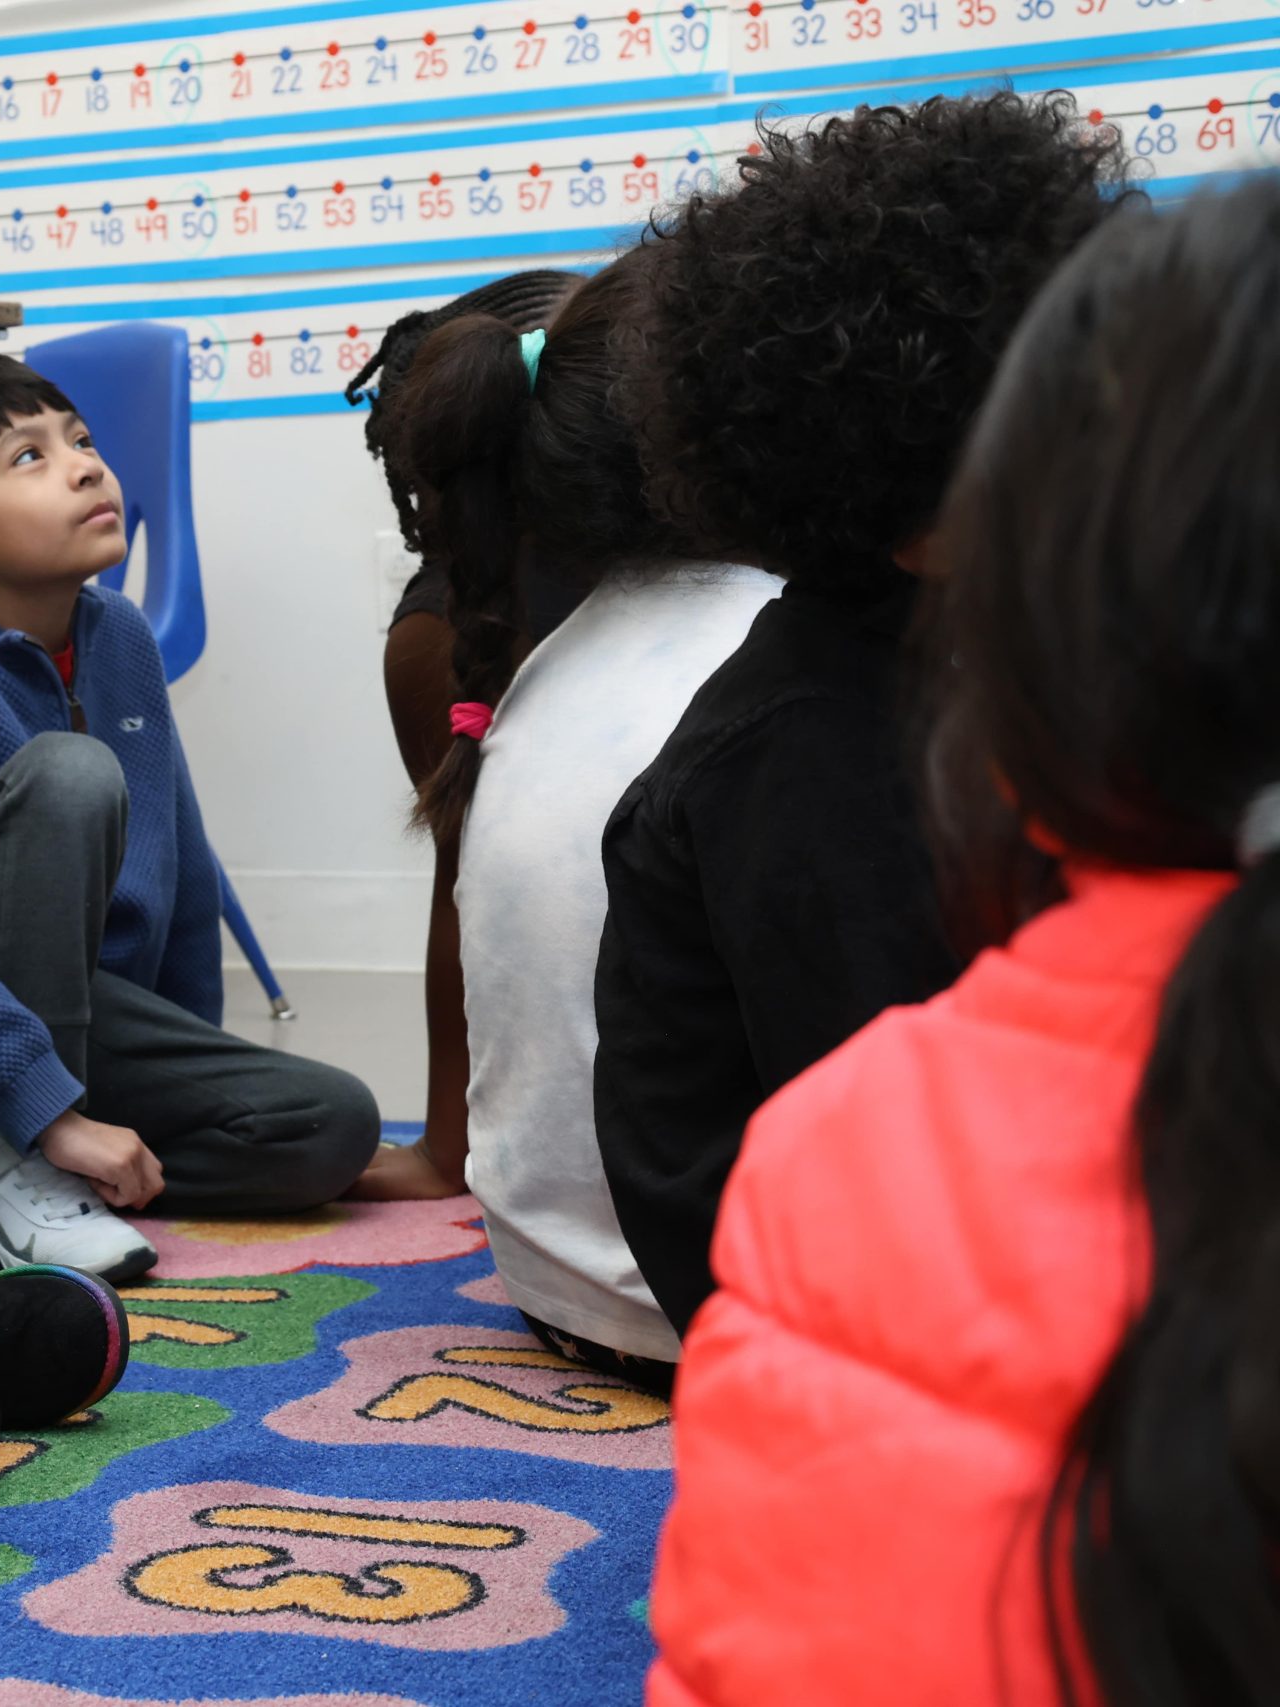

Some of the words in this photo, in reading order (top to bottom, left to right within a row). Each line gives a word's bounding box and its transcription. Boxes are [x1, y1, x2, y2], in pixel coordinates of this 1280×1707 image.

[42, 86, 62, 116] 17
[86, 82, 109, 112] 18
[130, 77, 151, 108] 19
[170, 77, 200, 106] 20
[230, 68, 251, 99] 21
[272, 64, 302, 95] 22
[320, 59, 350, 90] 23
[366, 55, 398, 86] 24
[415, 48, 448, 80] 25
[464, 44, 497, 76] 26
[514, 38, 546, 70] 27
[565, 32, 600, 65] 28
[618, 27, 652, 60] 29
[670, 24, 709, 54] 30
[744, 18, 769, 52] 31
[792, 14, 827, 47] 32
[845, 7, 882, 41] 33
[900, 1, 938, 35] 34
[957, 0, 997, 29] 35
[1132, 123, 1178, 158] 68
[1196, 117, 1235, 151] 69
[2, 226, 34, 252] 46
[47, 219, 78, 248] 47
[91, 218, 124, 245] 48
[135, 214, 168, 241] 49
[182, 212, 216, 240] 50
[233, 203, 256, 235] 51
[277, 202, 306, 231] 52
[323, 198, 355, 227] 53
[370, 195, 404, 224] 54
[418, 189, 454, 220] 55
[468, 186, 503, 216] 56
[518, 180, 553, 212] 57
[569, 176, 606, 208] 58
[623, 172, 659, 203] 59
[189, 354, 223, 381] 80
[248, 350, 272, 378] 81
[290, 346, 322, 375] 82
[337, 342, 371, 371] 83
[120, 1503, 527, 1625] 13
